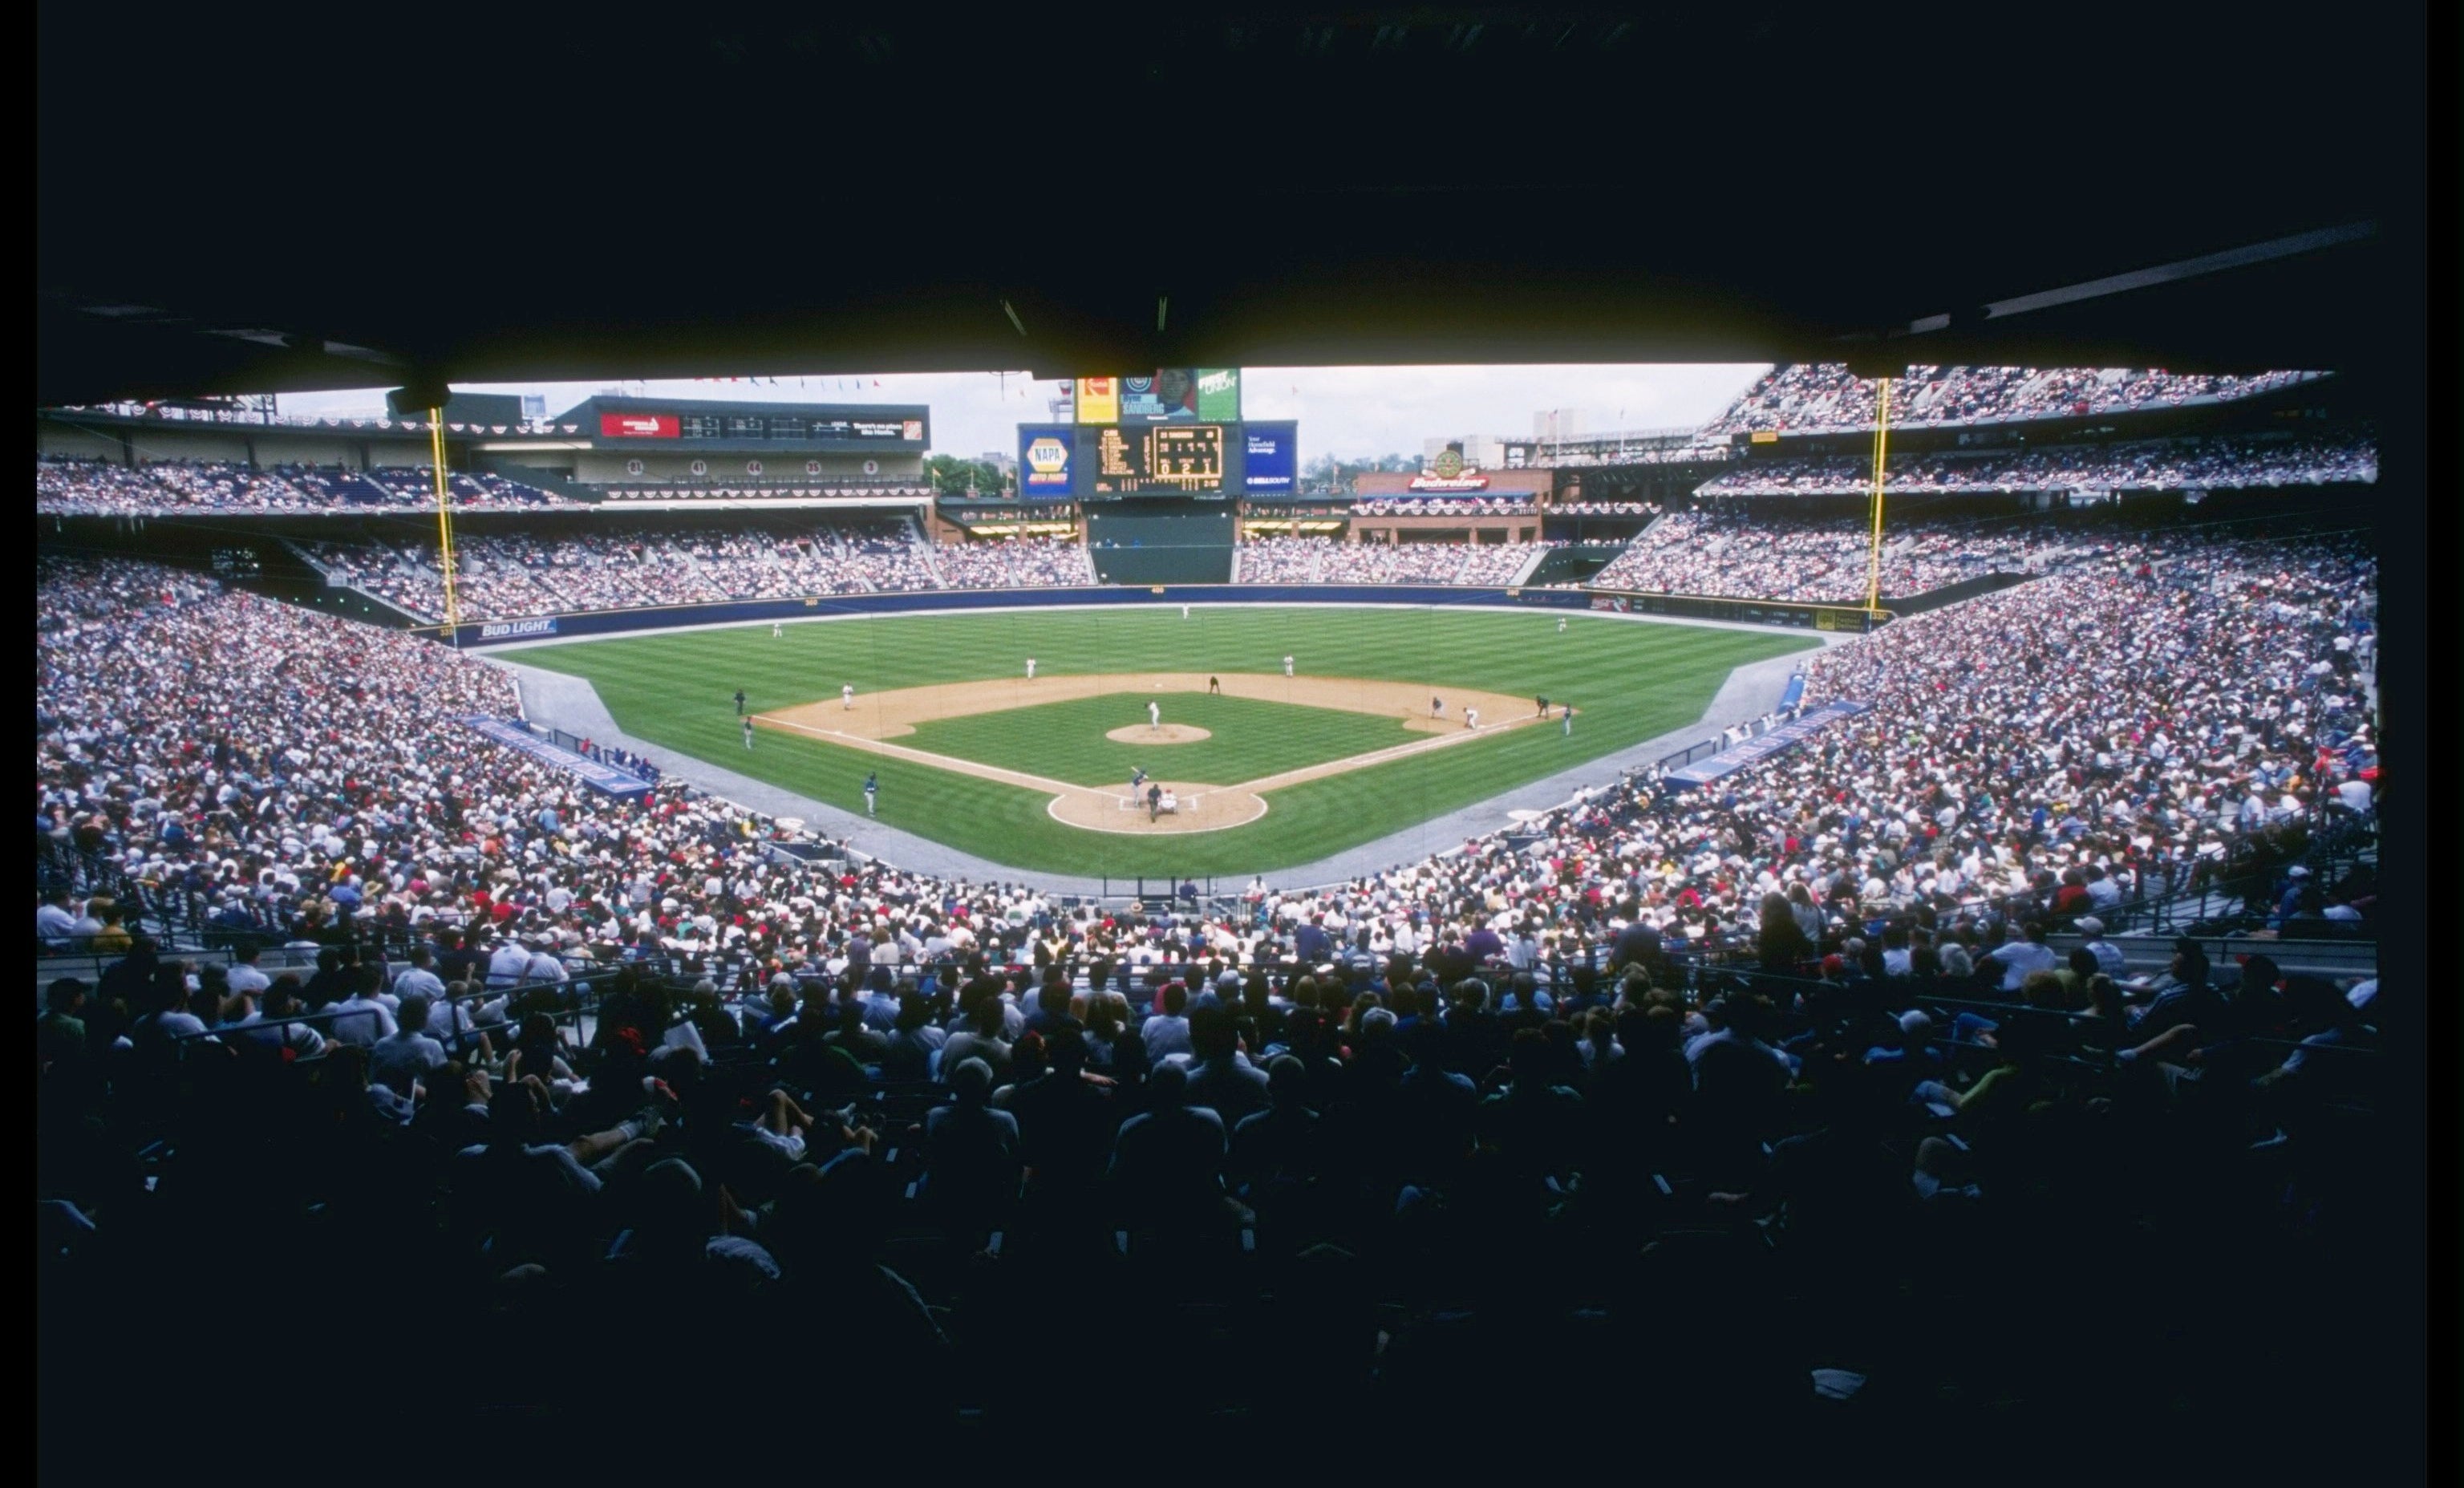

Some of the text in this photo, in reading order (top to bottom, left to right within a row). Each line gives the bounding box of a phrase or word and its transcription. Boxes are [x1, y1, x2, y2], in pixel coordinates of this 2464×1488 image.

[1205, 376, 1236, 394] UNION
[1123, 403, 1165, 414] SANDBERG
[1035, 447, 1060, 462] NAPA
[630, 462, 641, 472] 21
[693, 462, 703, 472] 41
[748, 462, 760, 472] 44
[808, 462, 819, 472] 35
[868, 462, 874, 472] 3
[1161, 464, 1211, 475] 0 2 1
[1410, 477, 1487, 488] Budweiser
[482, 620, 550, 636] BUD LIGHT
